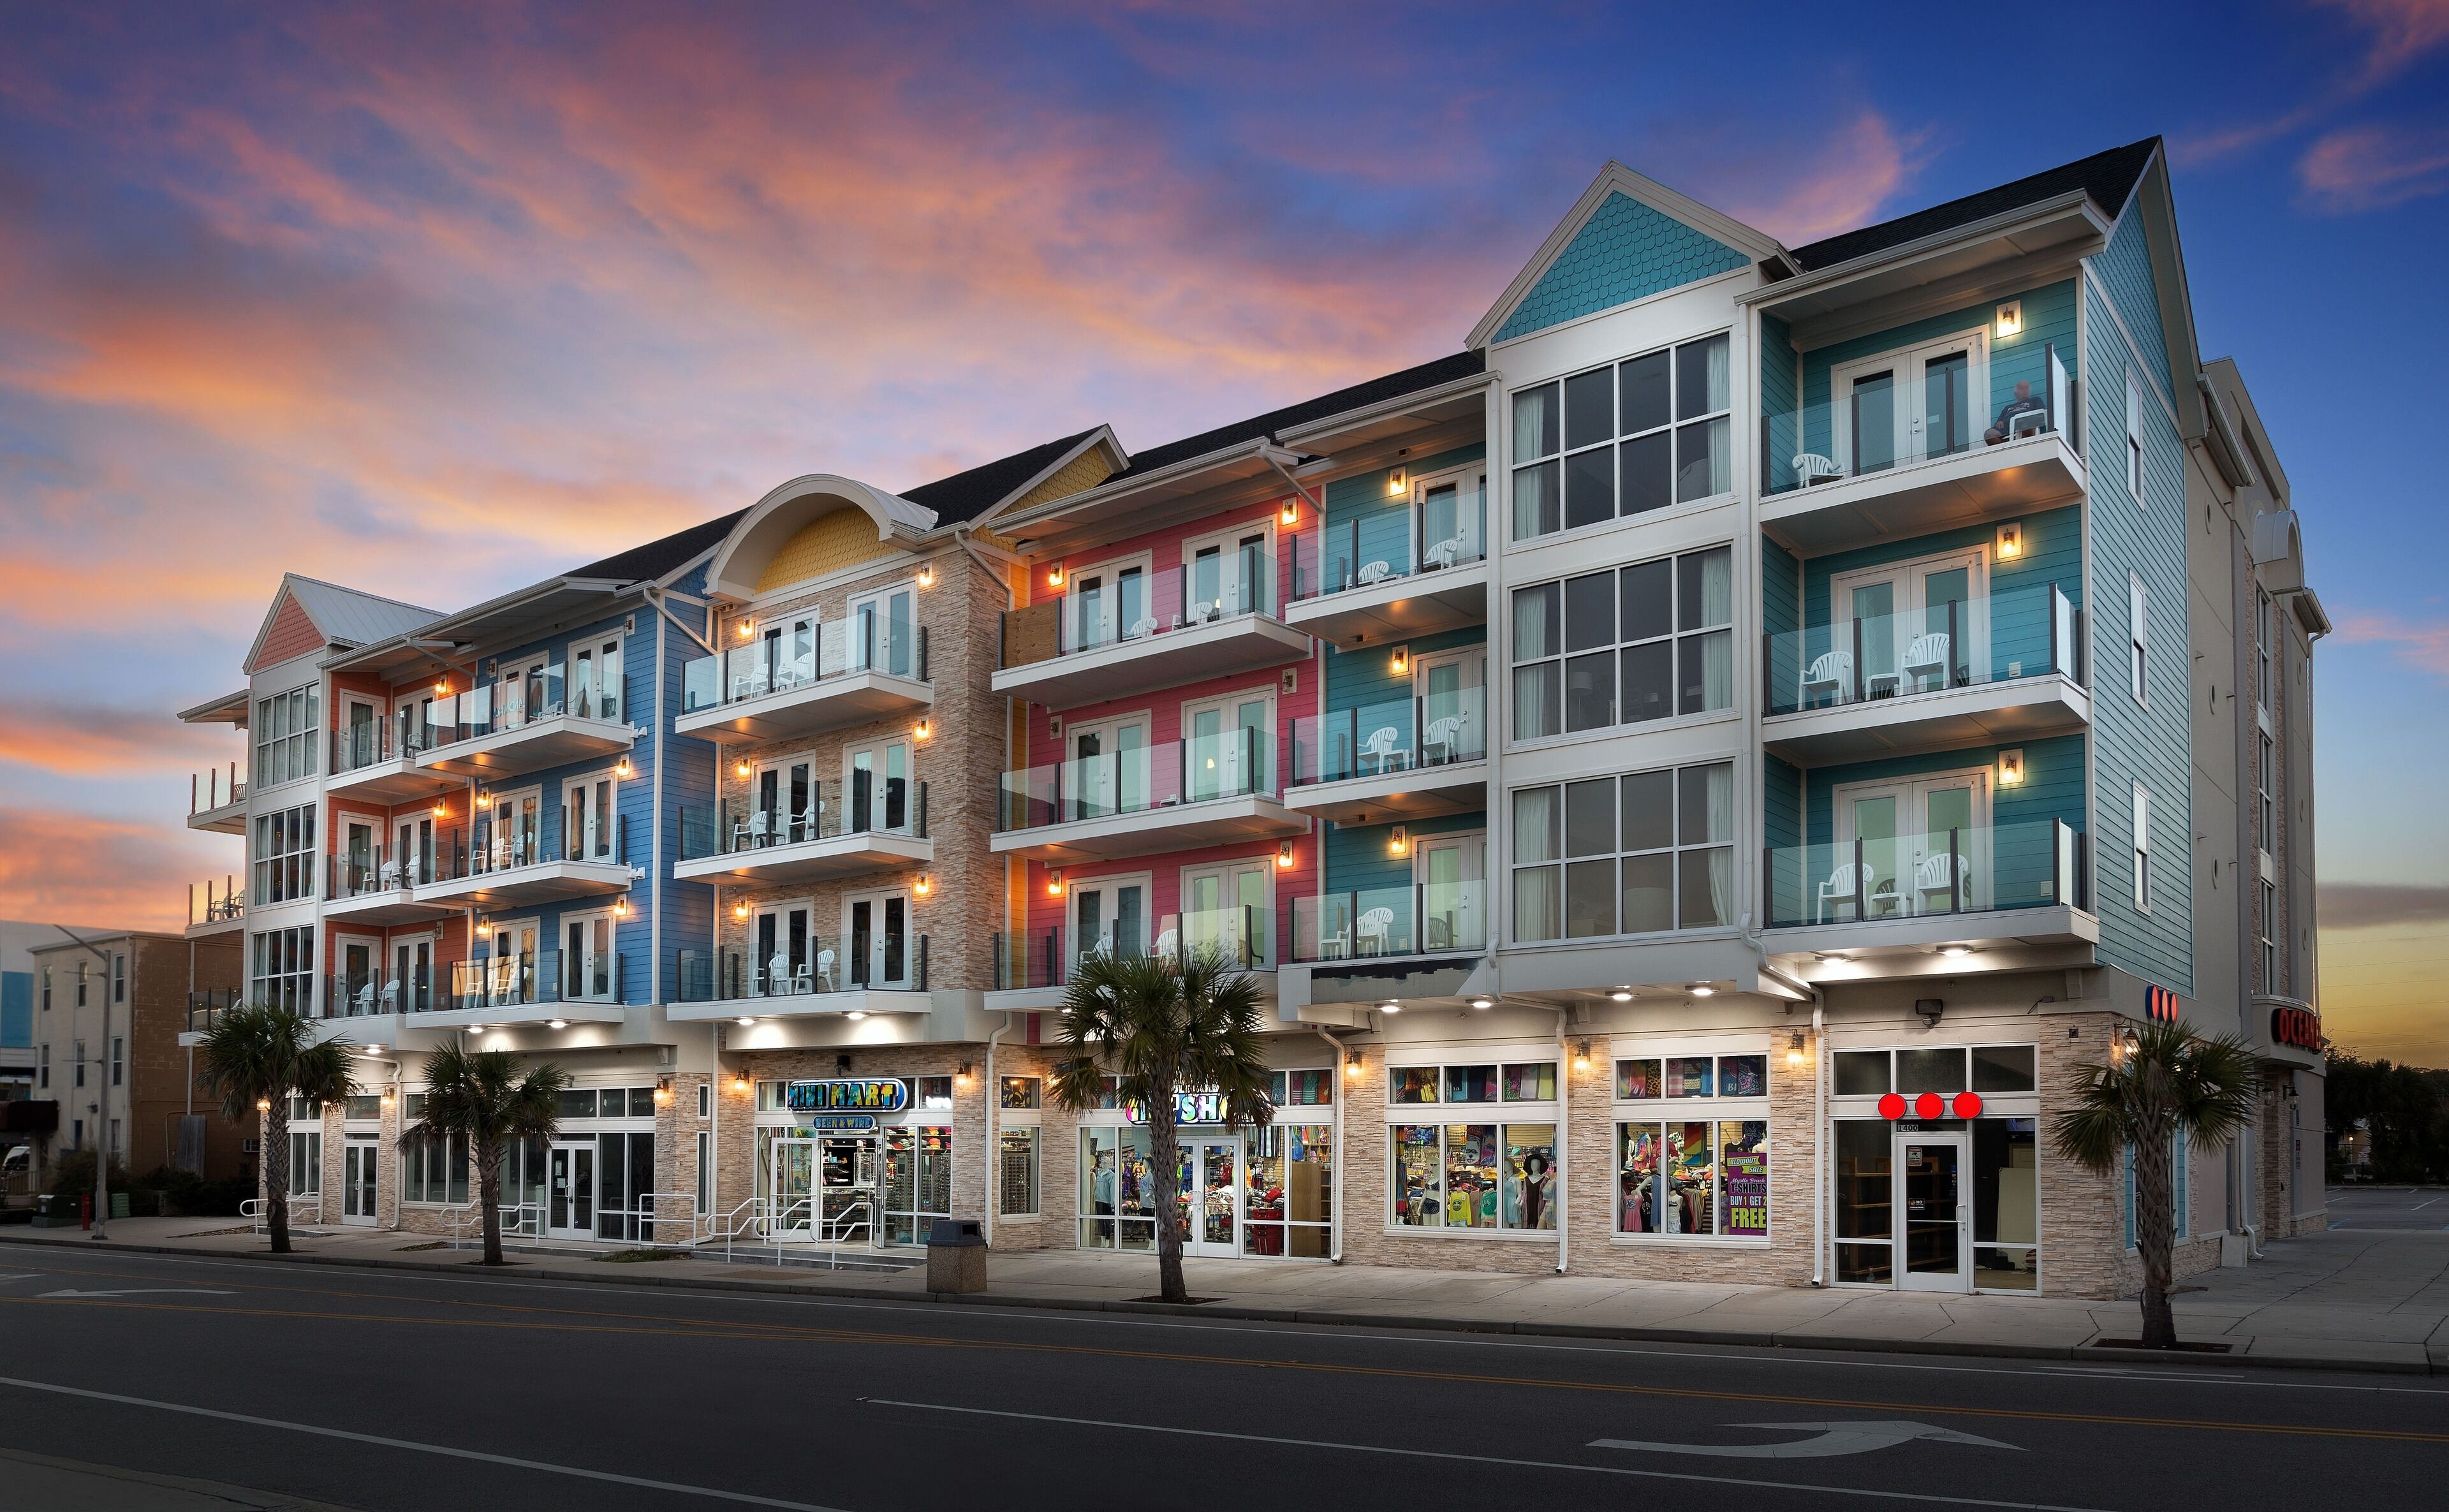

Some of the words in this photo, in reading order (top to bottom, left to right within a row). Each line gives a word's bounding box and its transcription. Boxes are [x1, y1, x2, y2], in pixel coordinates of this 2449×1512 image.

[788, 1083, 825, 1107] MINI
[830, 1083, 894, 1107] MART
[815, 1117, 837, 1128] BEER
[839, 1117, 845, 1128] &
[846, 1117, 871, 1128] WINE
[1730, 1183, 1767, 1194] T-SHIRTS
[1730, 1196, 1742, 1206] BUY
[1743, 1196, 1747, 1206] 1
[1749, 1196, 1762, 1206] GET
[1731, 1207, 1767, 1228] FREE
